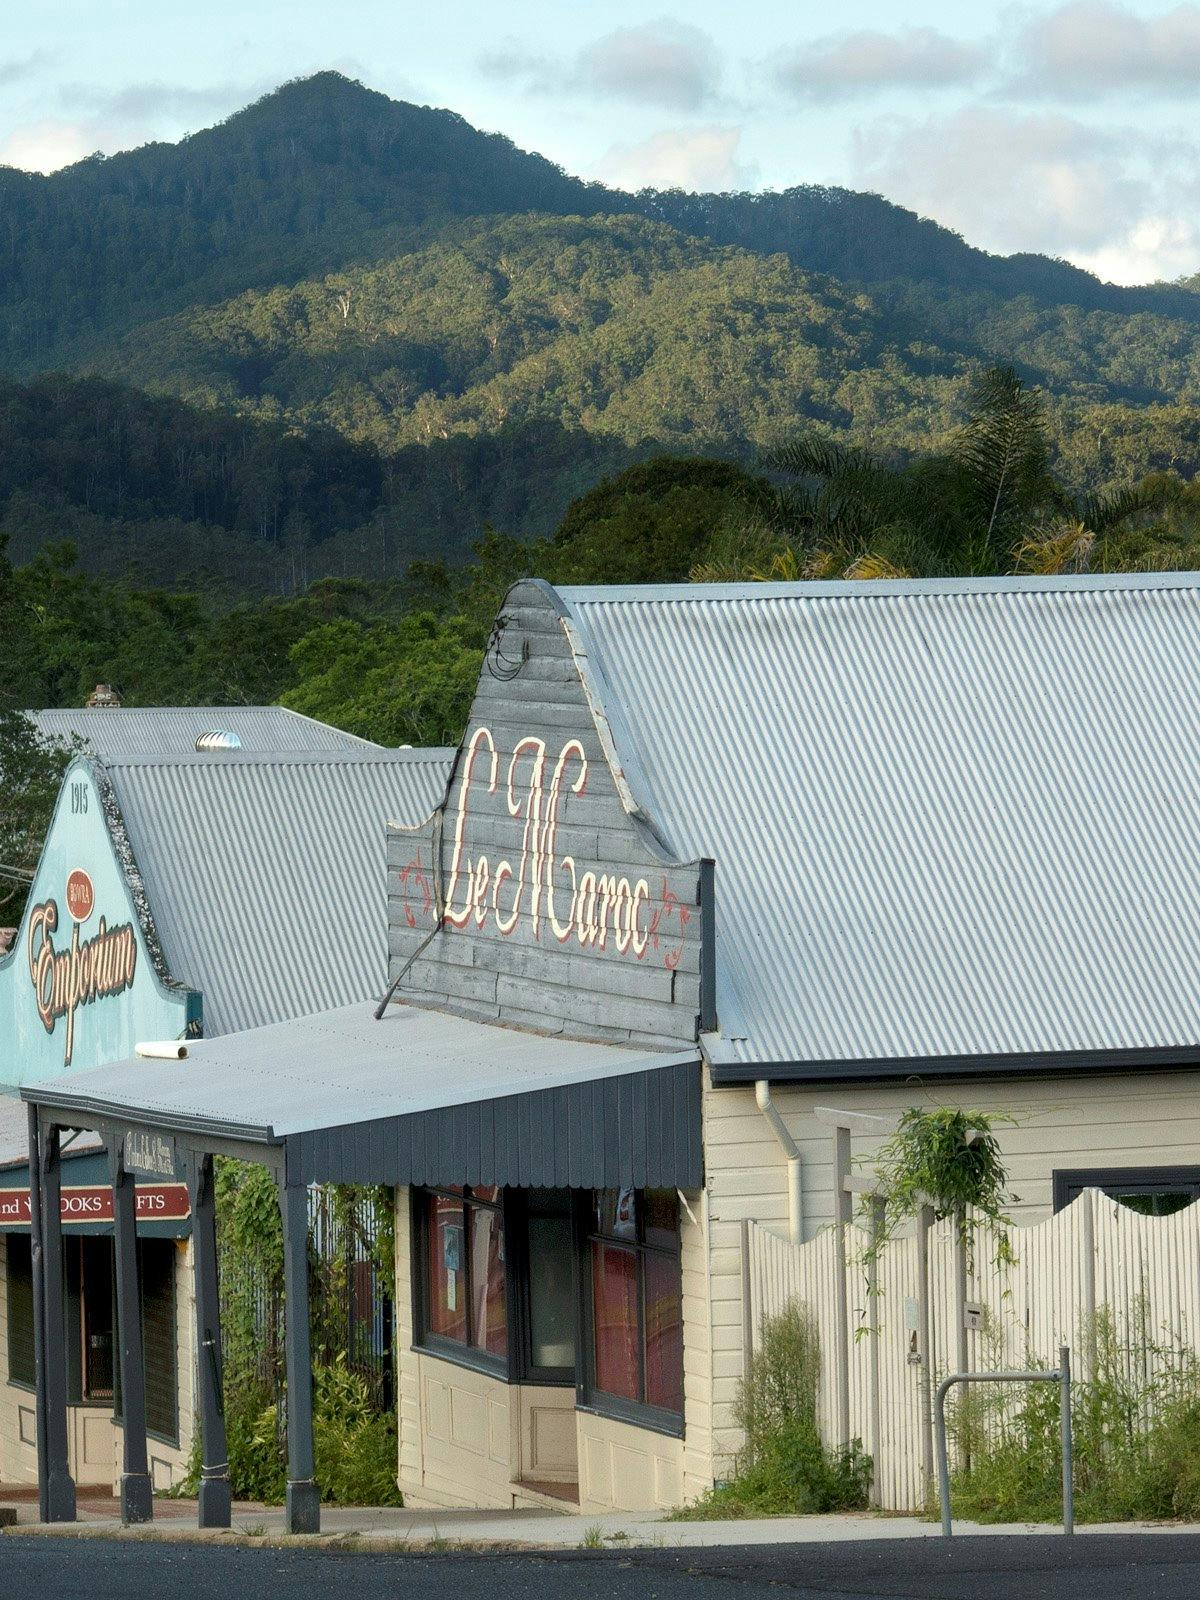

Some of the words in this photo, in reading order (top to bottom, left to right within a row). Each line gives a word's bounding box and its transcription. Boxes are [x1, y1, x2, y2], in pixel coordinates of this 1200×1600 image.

[71, 782, 88, 814] 1915
[28, 898, 137, 1067] Emporium
[60, 1196, 102, 1213] OOKS
[136, 1194, 165, 1210] FTS
